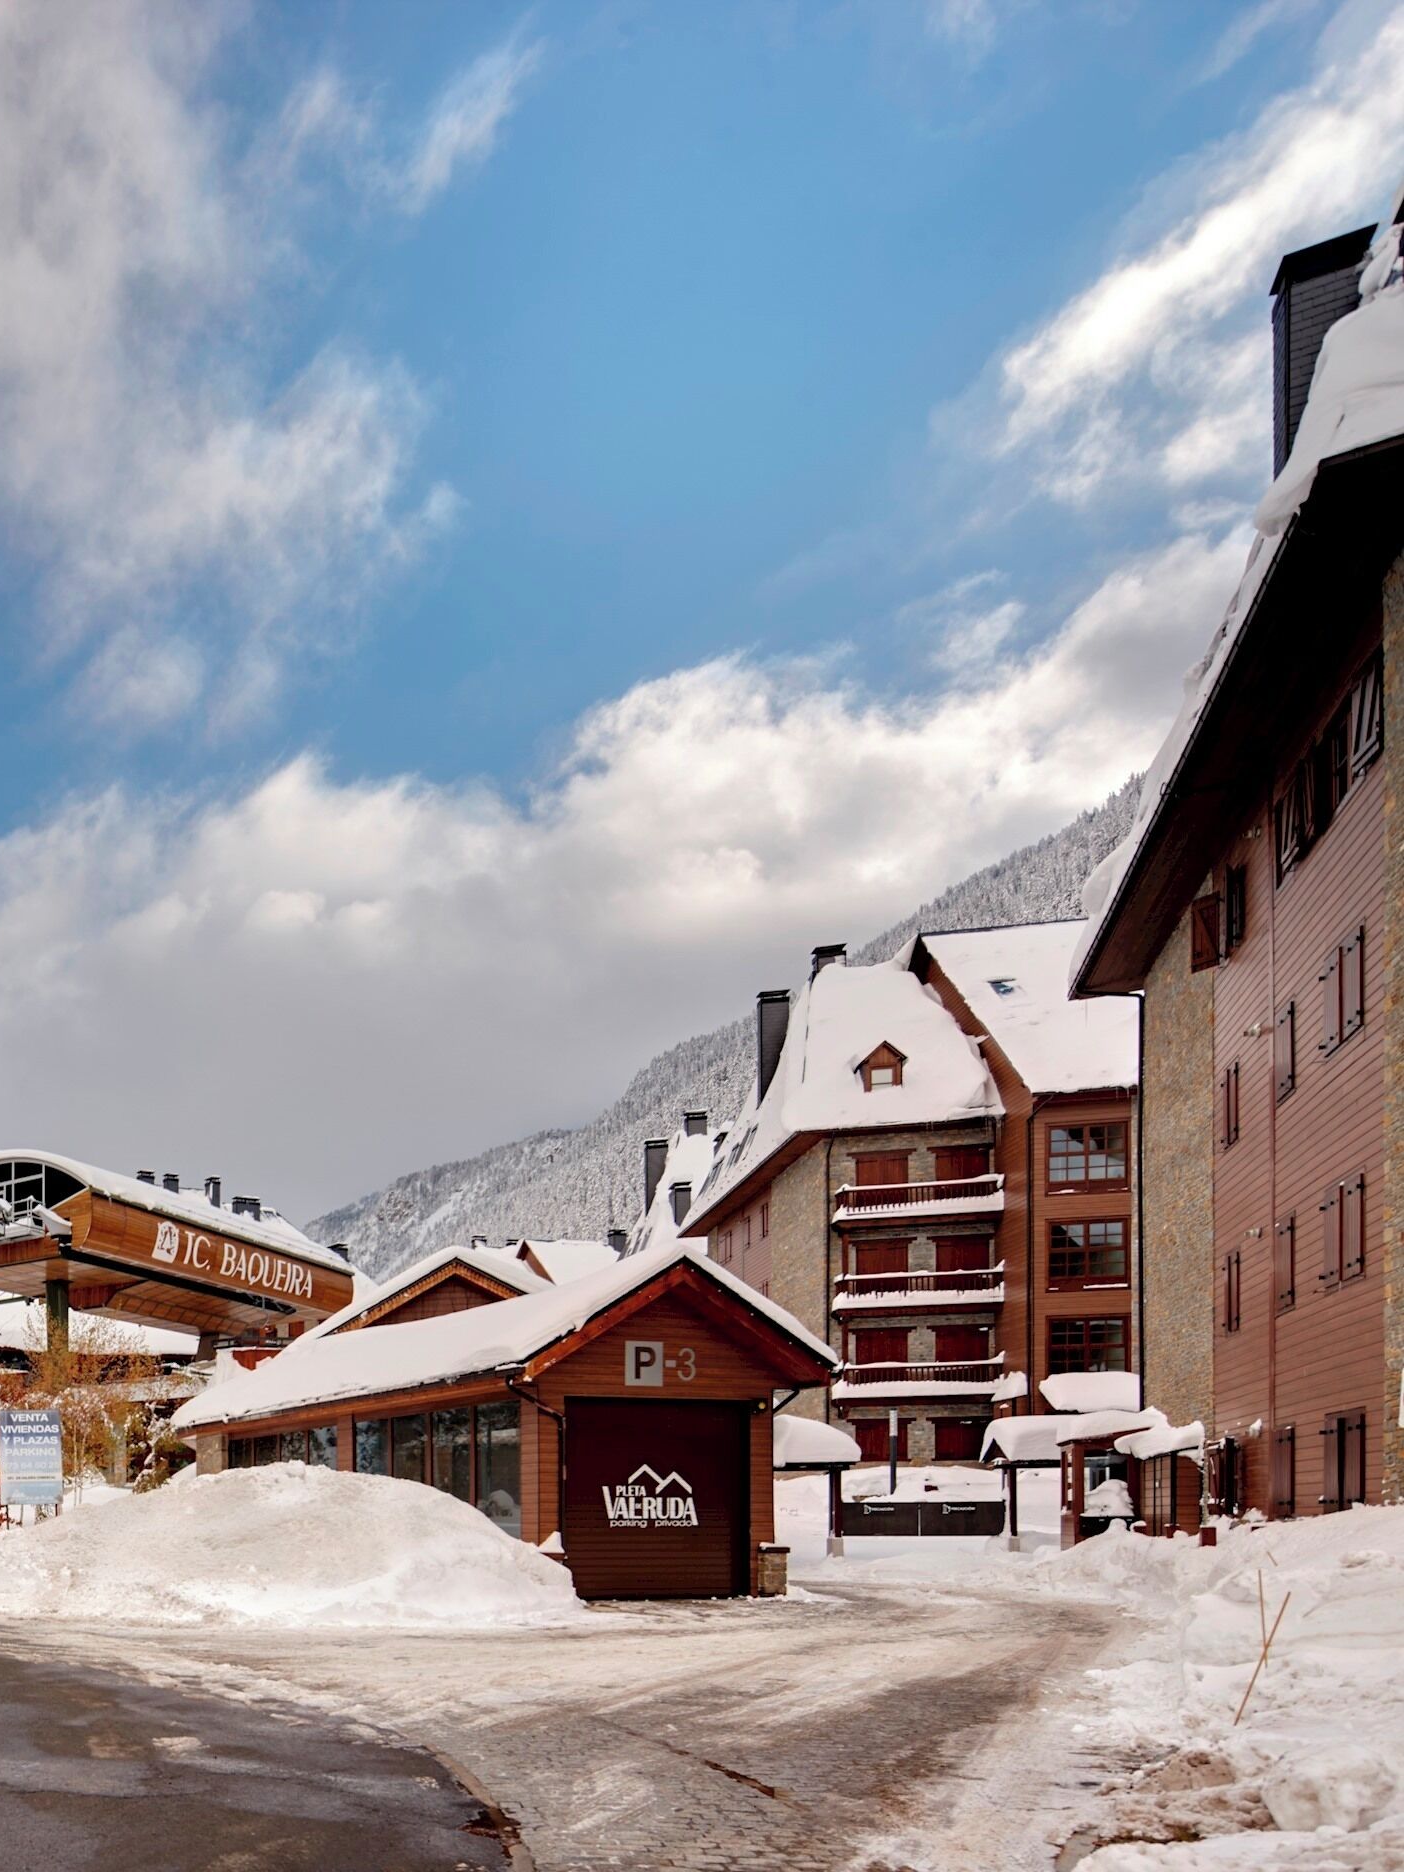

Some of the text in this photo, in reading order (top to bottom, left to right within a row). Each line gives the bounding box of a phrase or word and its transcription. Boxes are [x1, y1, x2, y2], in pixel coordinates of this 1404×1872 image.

[183, 1230, 313, 1299] TC. BAQUEIRA
[10, 1413, 49, 1422] VENTA
[0, 1424, 60, 1434] VIVIENDAS
[2, 1435, 59, 1445] Y PLAZAS
[5, 1447, 56, 1457] PARKING
[615, 1485, 647, 1497] PLETA
[609, 1519, 693, 1529] parking privado
